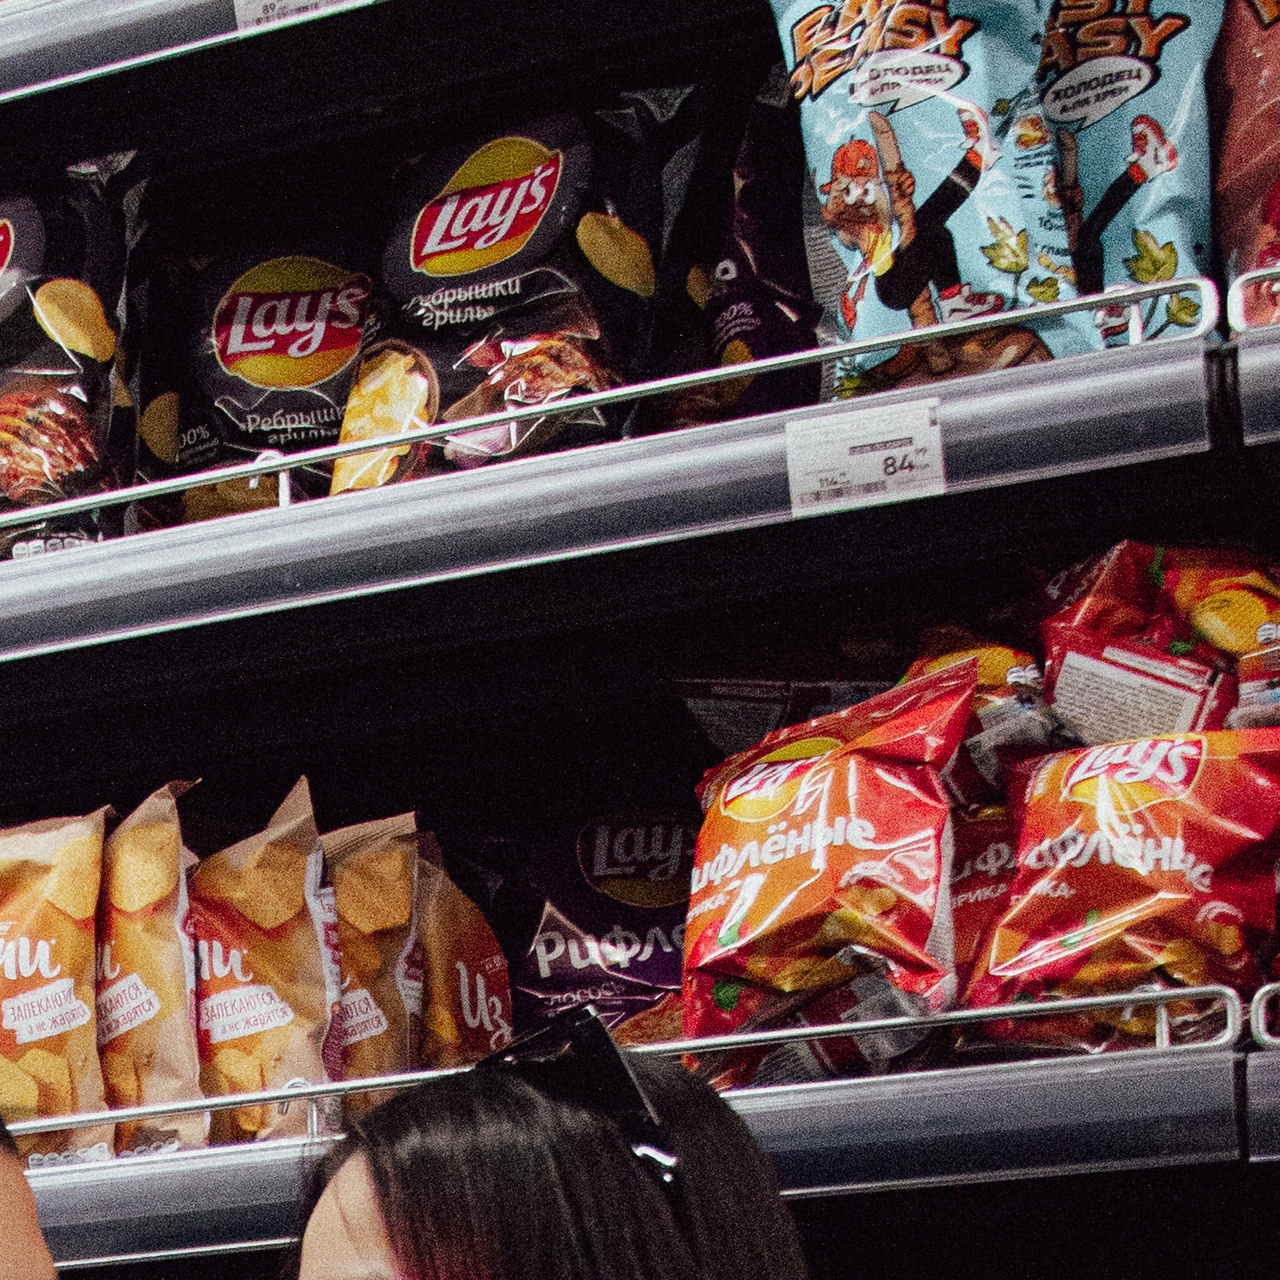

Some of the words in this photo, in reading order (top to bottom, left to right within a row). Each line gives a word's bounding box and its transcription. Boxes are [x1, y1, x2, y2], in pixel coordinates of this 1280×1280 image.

[420, 165, 556, 257] Lay's
[882, 454, 915, 477] 84
[690, 816, 877, 895] ифлёные
